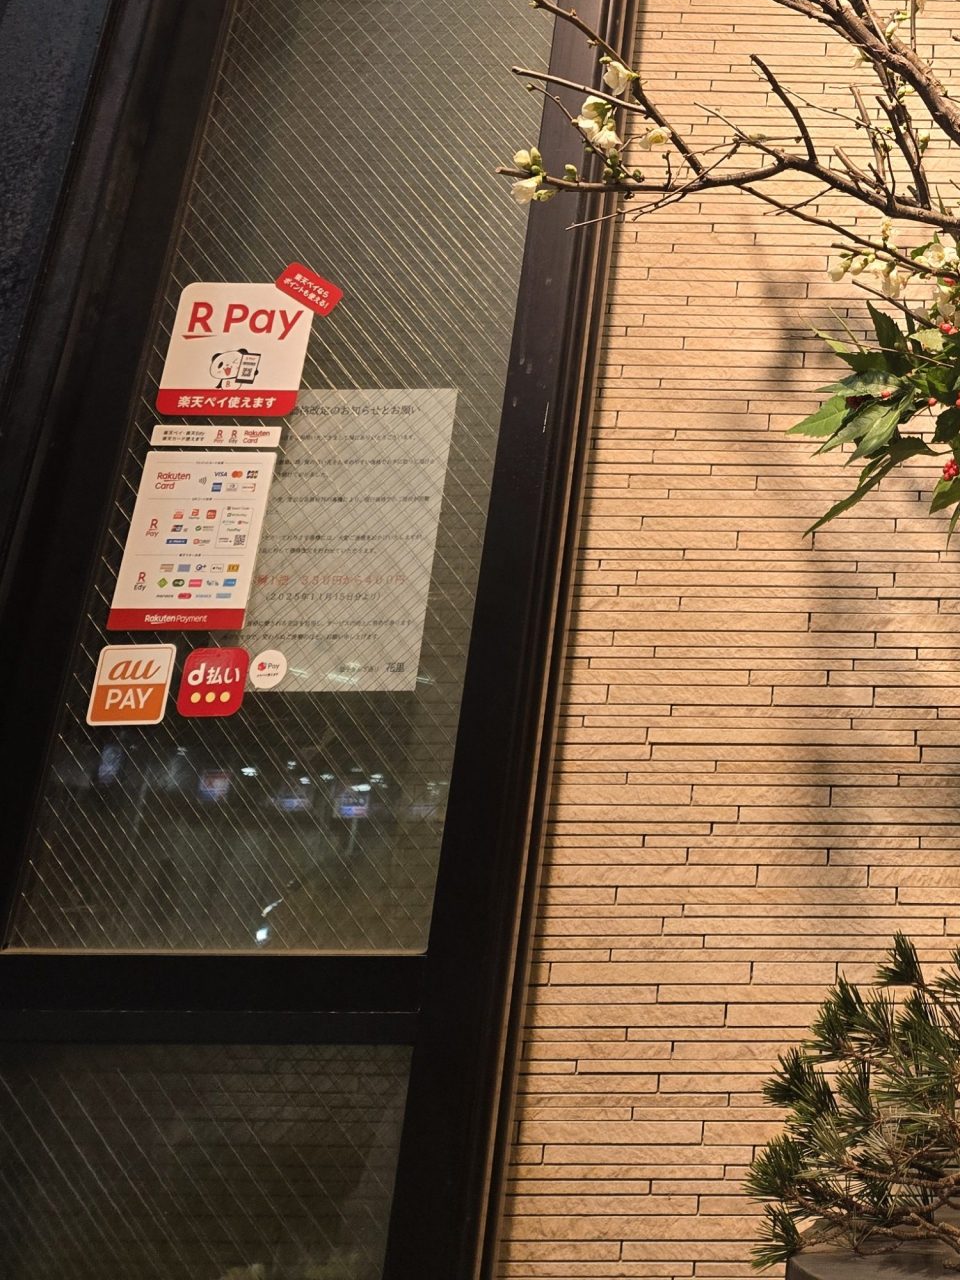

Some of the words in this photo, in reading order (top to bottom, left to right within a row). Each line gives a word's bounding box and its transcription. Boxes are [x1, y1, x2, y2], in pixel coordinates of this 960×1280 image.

[223, 303, 303, 340] Pay
[177, 396, 277, 409] 楽天ペイ使えます
[244, 430, 271, 438] Rakuten
[156, 471, 191, 481] Rakuten
[154, 482, 176, 490] Card
[144, 614, 176, 624] Rakuten
[176, 615, 208, 624] Payment
[107, 658, 161, 681] au
[188, 663, 240, 686] d払い
[104, 687, 154, 710] PAY
